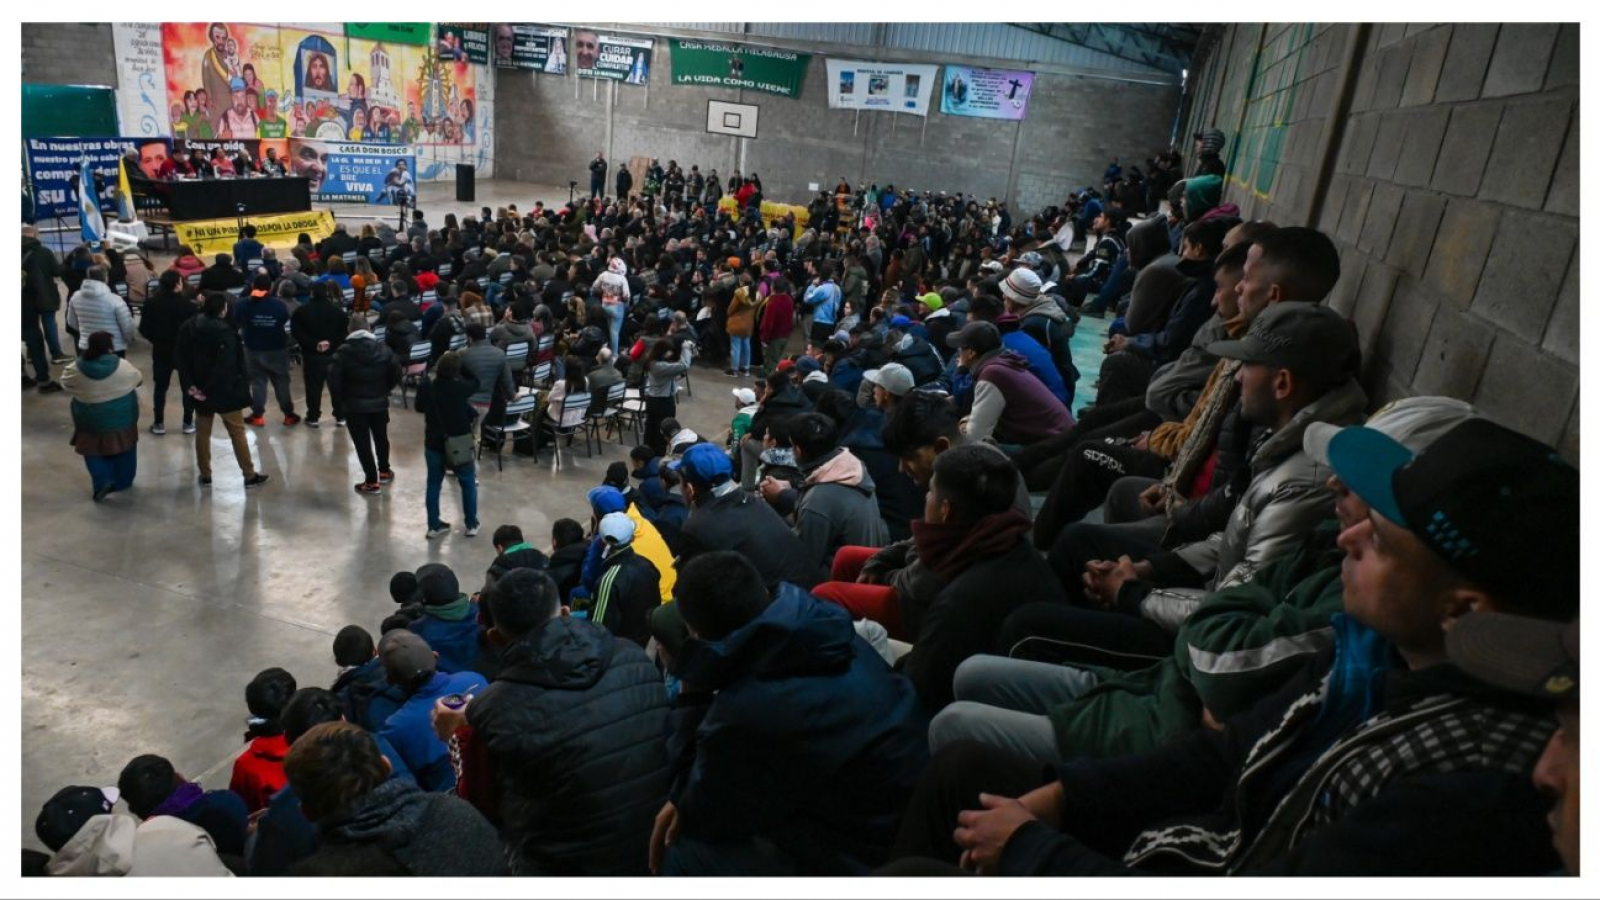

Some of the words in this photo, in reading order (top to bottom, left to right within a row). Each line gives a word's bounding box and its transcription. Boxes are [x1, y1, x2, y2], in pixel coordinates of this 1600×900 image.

[602, 44, 631, 55] CURAR
[679, 40, 703, 50] CASA
[599, 52, 633, 65] CUIDAR
[678, 74, 692, 82] LA
[693, 75, 721, 84] VIDA
[723, 78, 755, 87] COMO
[30, 139, 47, 150] En
[49, 141, 102, 151] nuestras
[103, 140, 135, 151] obras
[184, 139, 206, 150] Con
[339, 146, 361, 154] CASA
[362, 147, 380, 155] DON
[34, 155, 68, 164] nuestro
[340, 165, 351, 173] ES
[352, 166, 371, 174] QUE
[345, 182, 374, 192] VIVA
[38, 189, 66, 205] su
